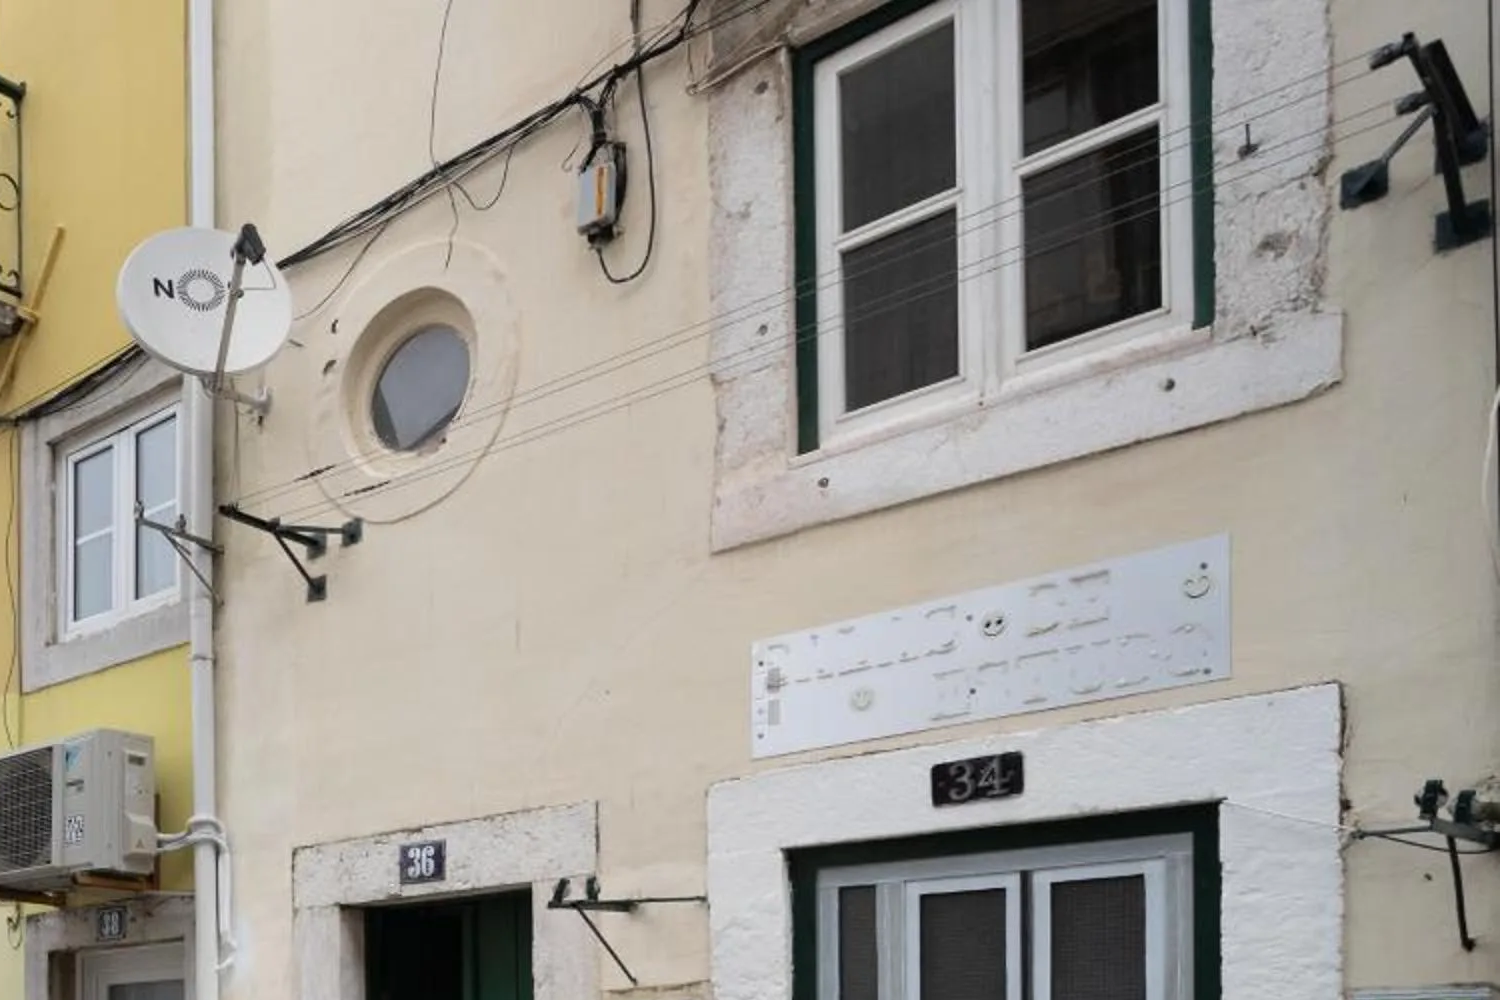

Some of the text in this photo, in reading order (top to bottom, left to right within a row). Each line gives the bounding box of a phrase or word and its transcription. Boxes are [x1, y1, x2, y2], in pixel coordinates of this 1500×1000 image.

[948, 755, 1016, 801] 34
[407, 845, 436, 878] 36
[101, 911, 120, 936] 38
